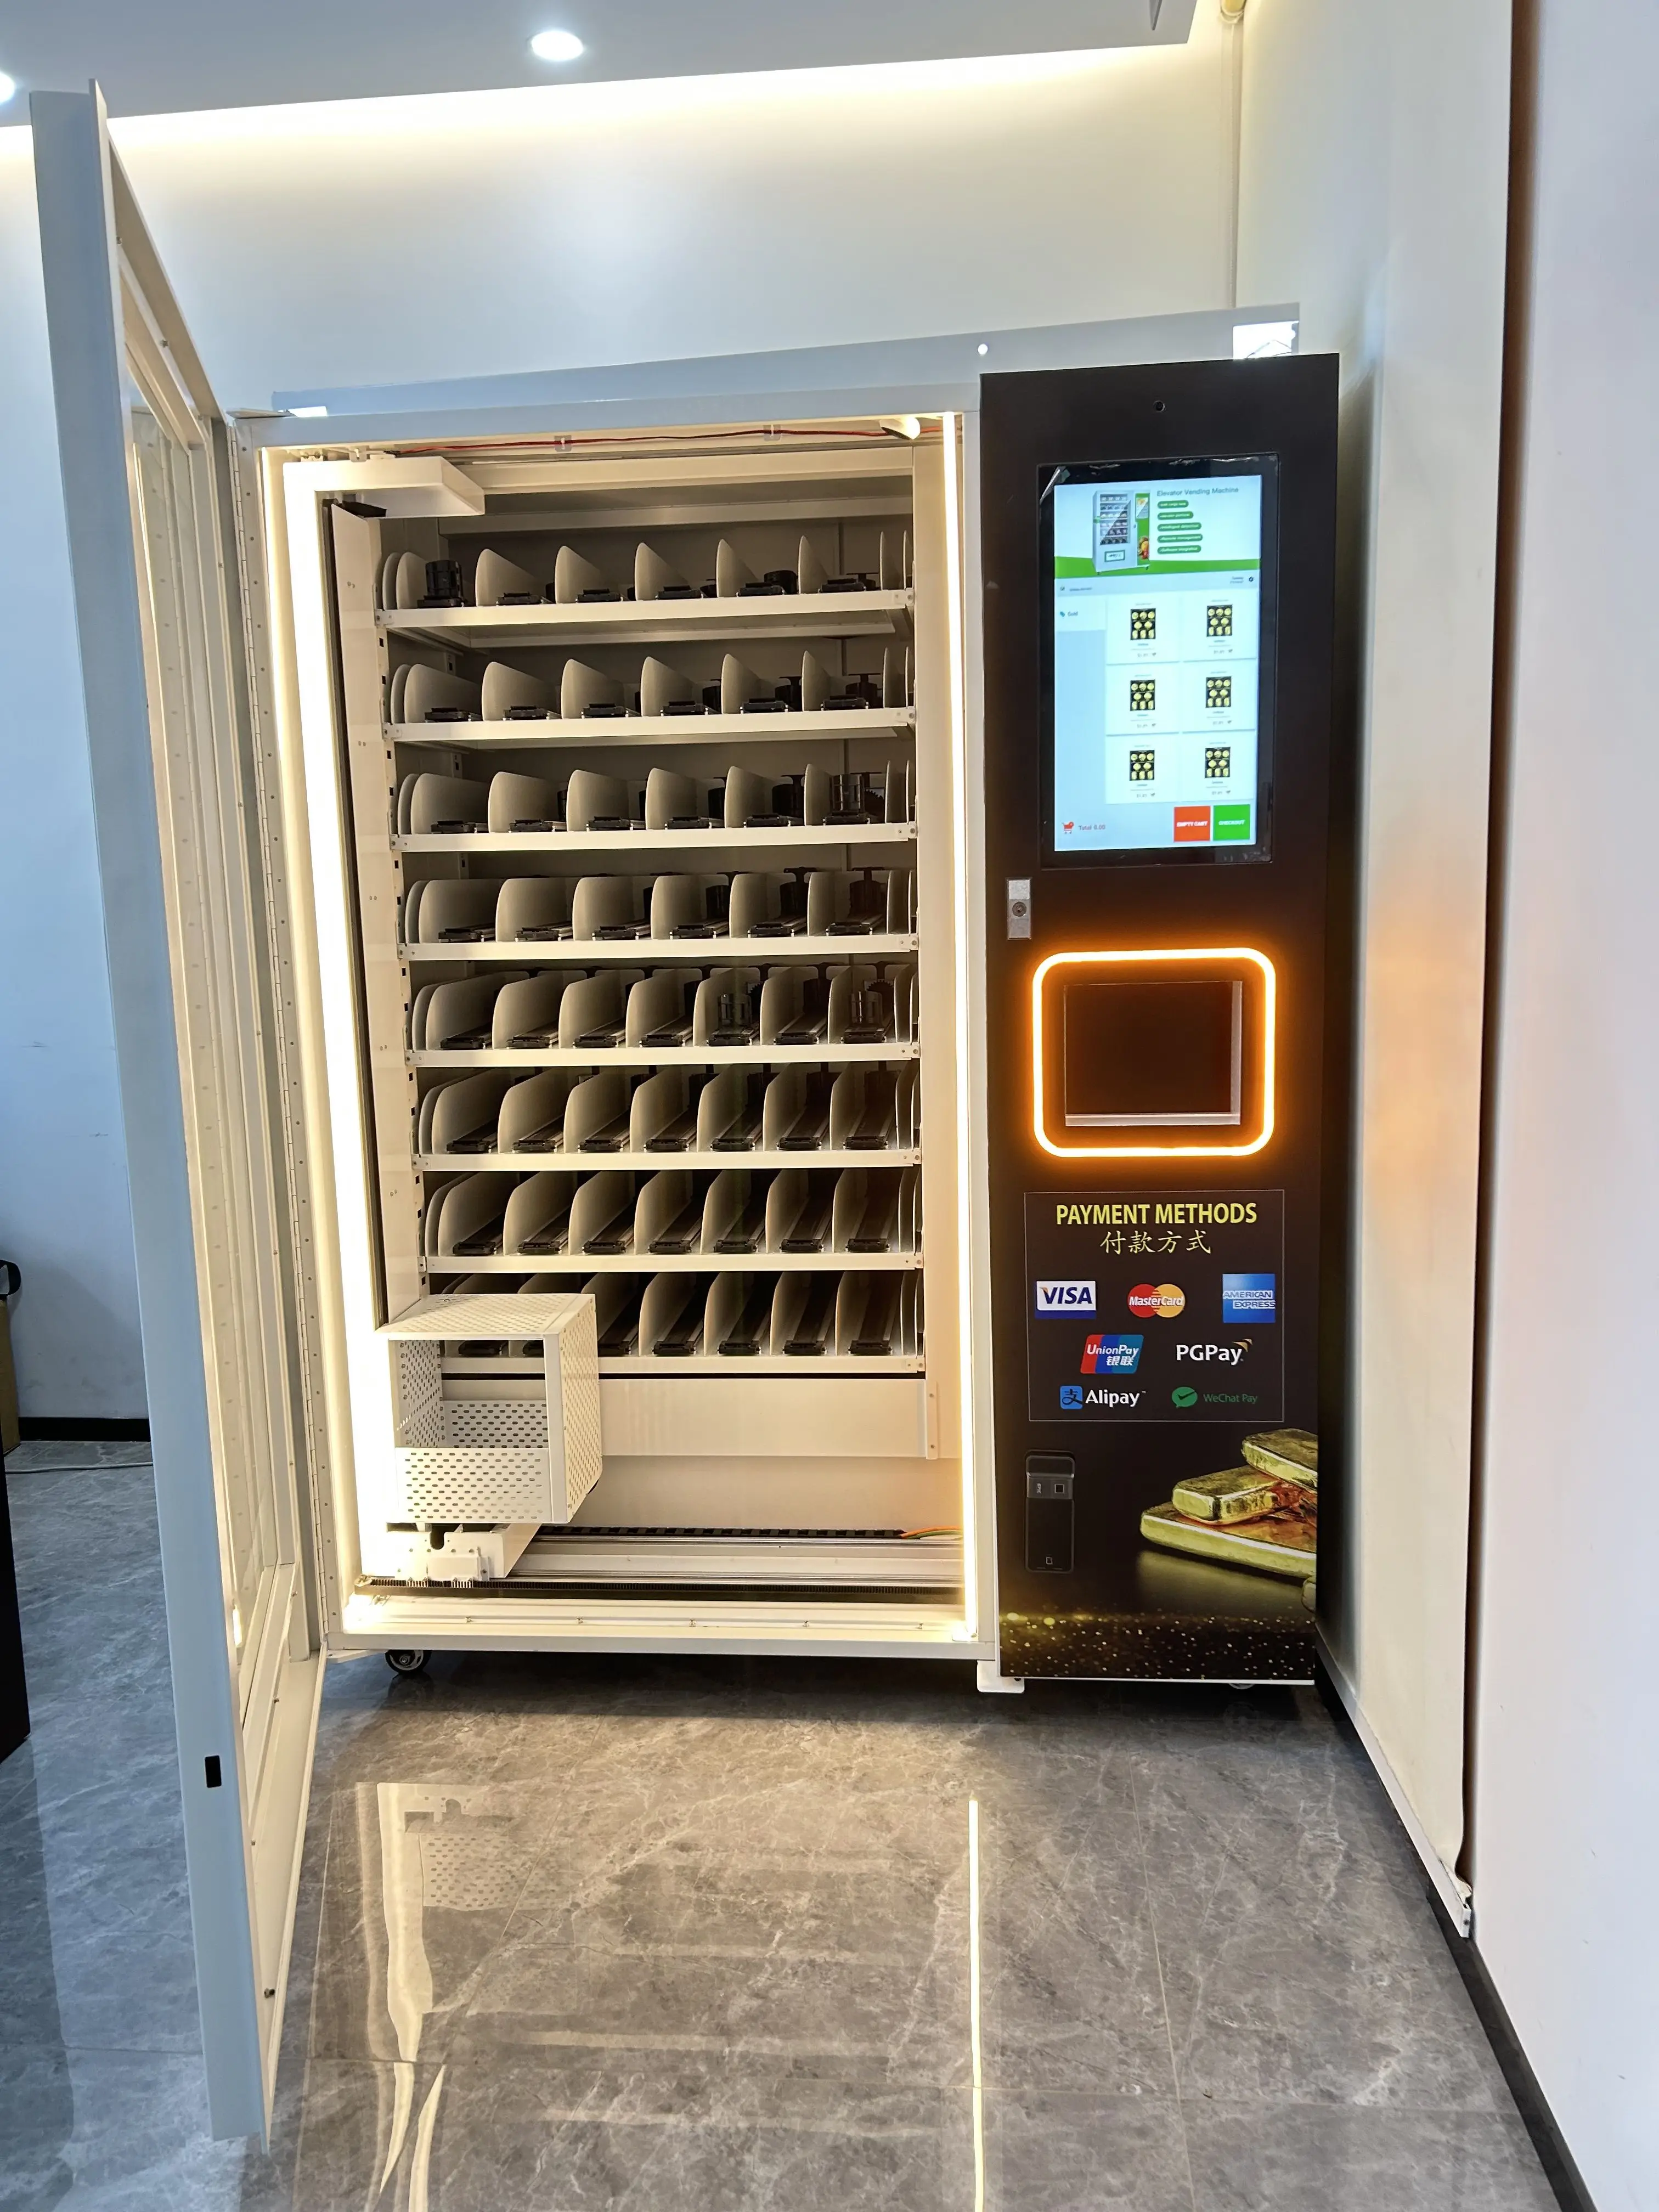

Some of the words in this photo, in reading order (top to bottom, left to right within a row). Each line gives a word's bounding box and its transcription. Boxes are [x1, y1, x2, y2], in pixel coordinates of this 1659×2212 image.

[1056, 1204, 1150, 1224] PAYMENT
[1155, 1203, 1257, 1224] METHODS
[1099, 1229, 1211, 1255] 付款方式
[1041, 1286, 1093, 1304] VISA
[1129, 1296, 1184, 1306] MasterCard
[1087, 1344, 1139, 1358] UnionPay
[1176, 1344, 1243, 1366] PGPay
[1106, 1356, 1134, 1366] 银联
[1085, 1389, 1140, 1408] Alipay
[1203, 1393, 1240, 1403] WeChat
[1242, 1393, 1258, 1404] Pay
